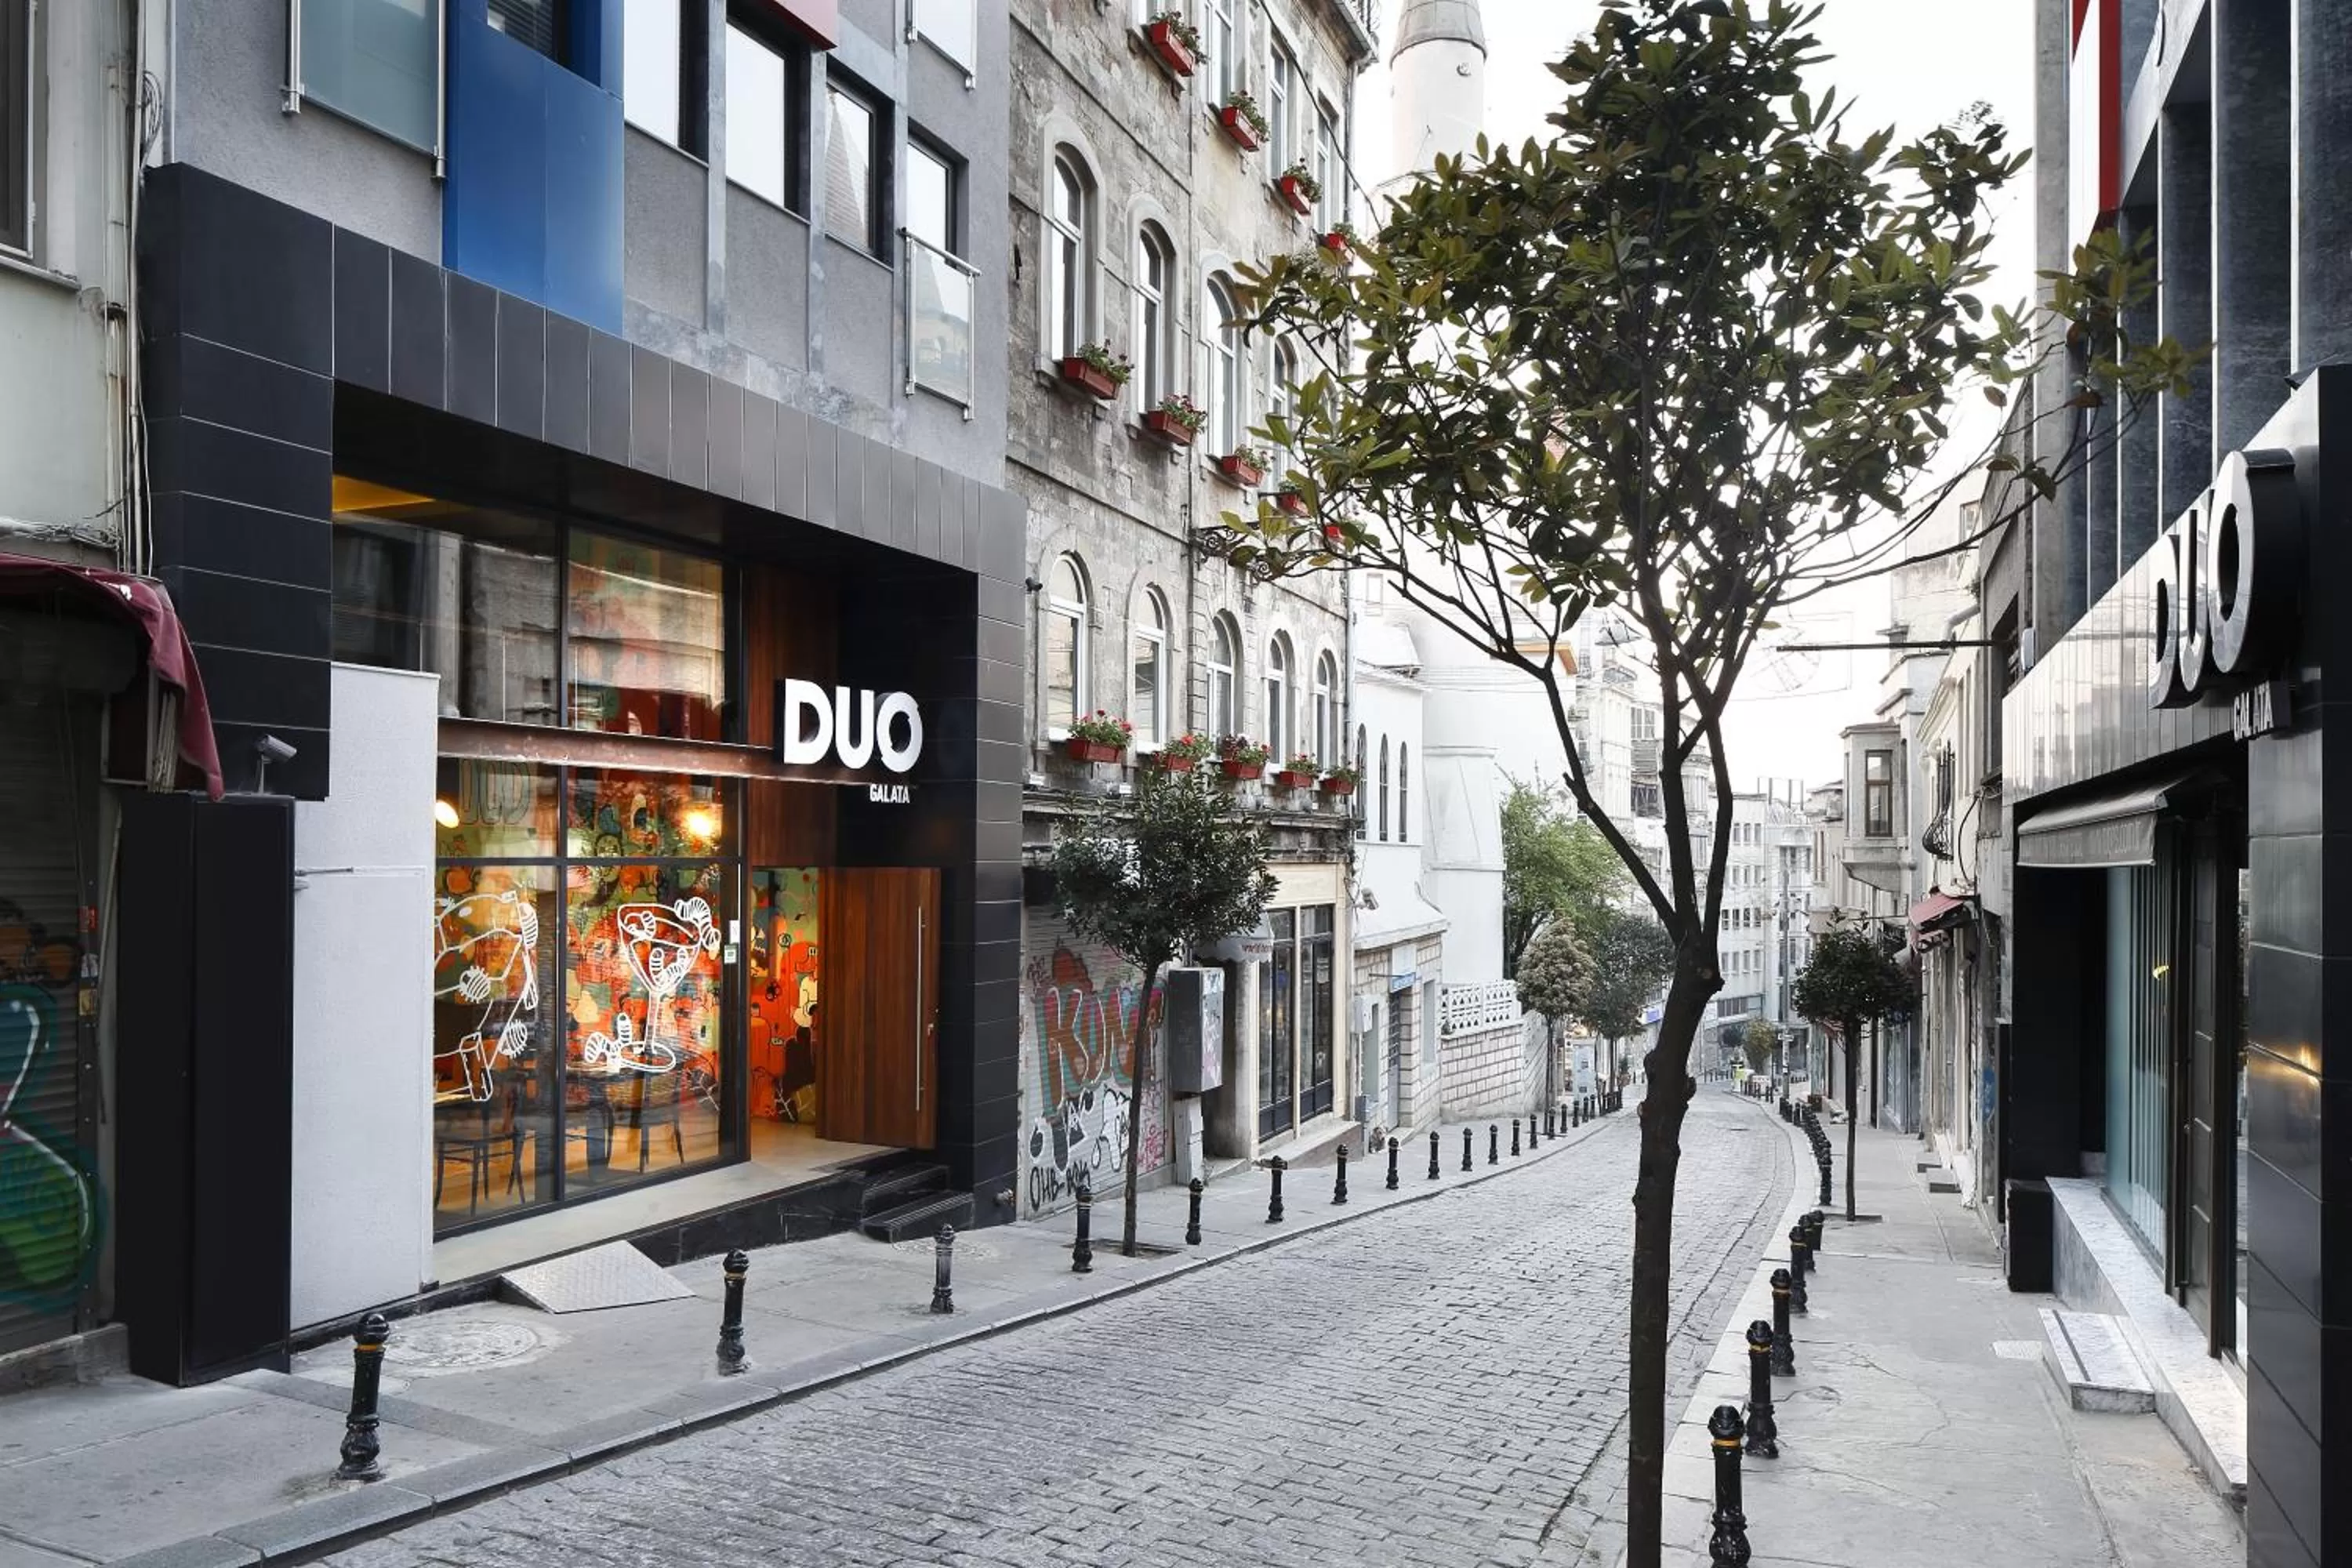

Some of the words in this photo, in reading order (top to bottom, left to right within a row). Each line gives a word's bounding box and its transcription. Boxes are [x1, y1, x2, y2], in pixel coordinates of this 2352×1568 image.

[2148, 450, 2255, 709] DUO
[783, 677, 924, 773] DUO
[2233, 680, 2274, 742] GALATA
[869, 784, 910, 804] GALATA
